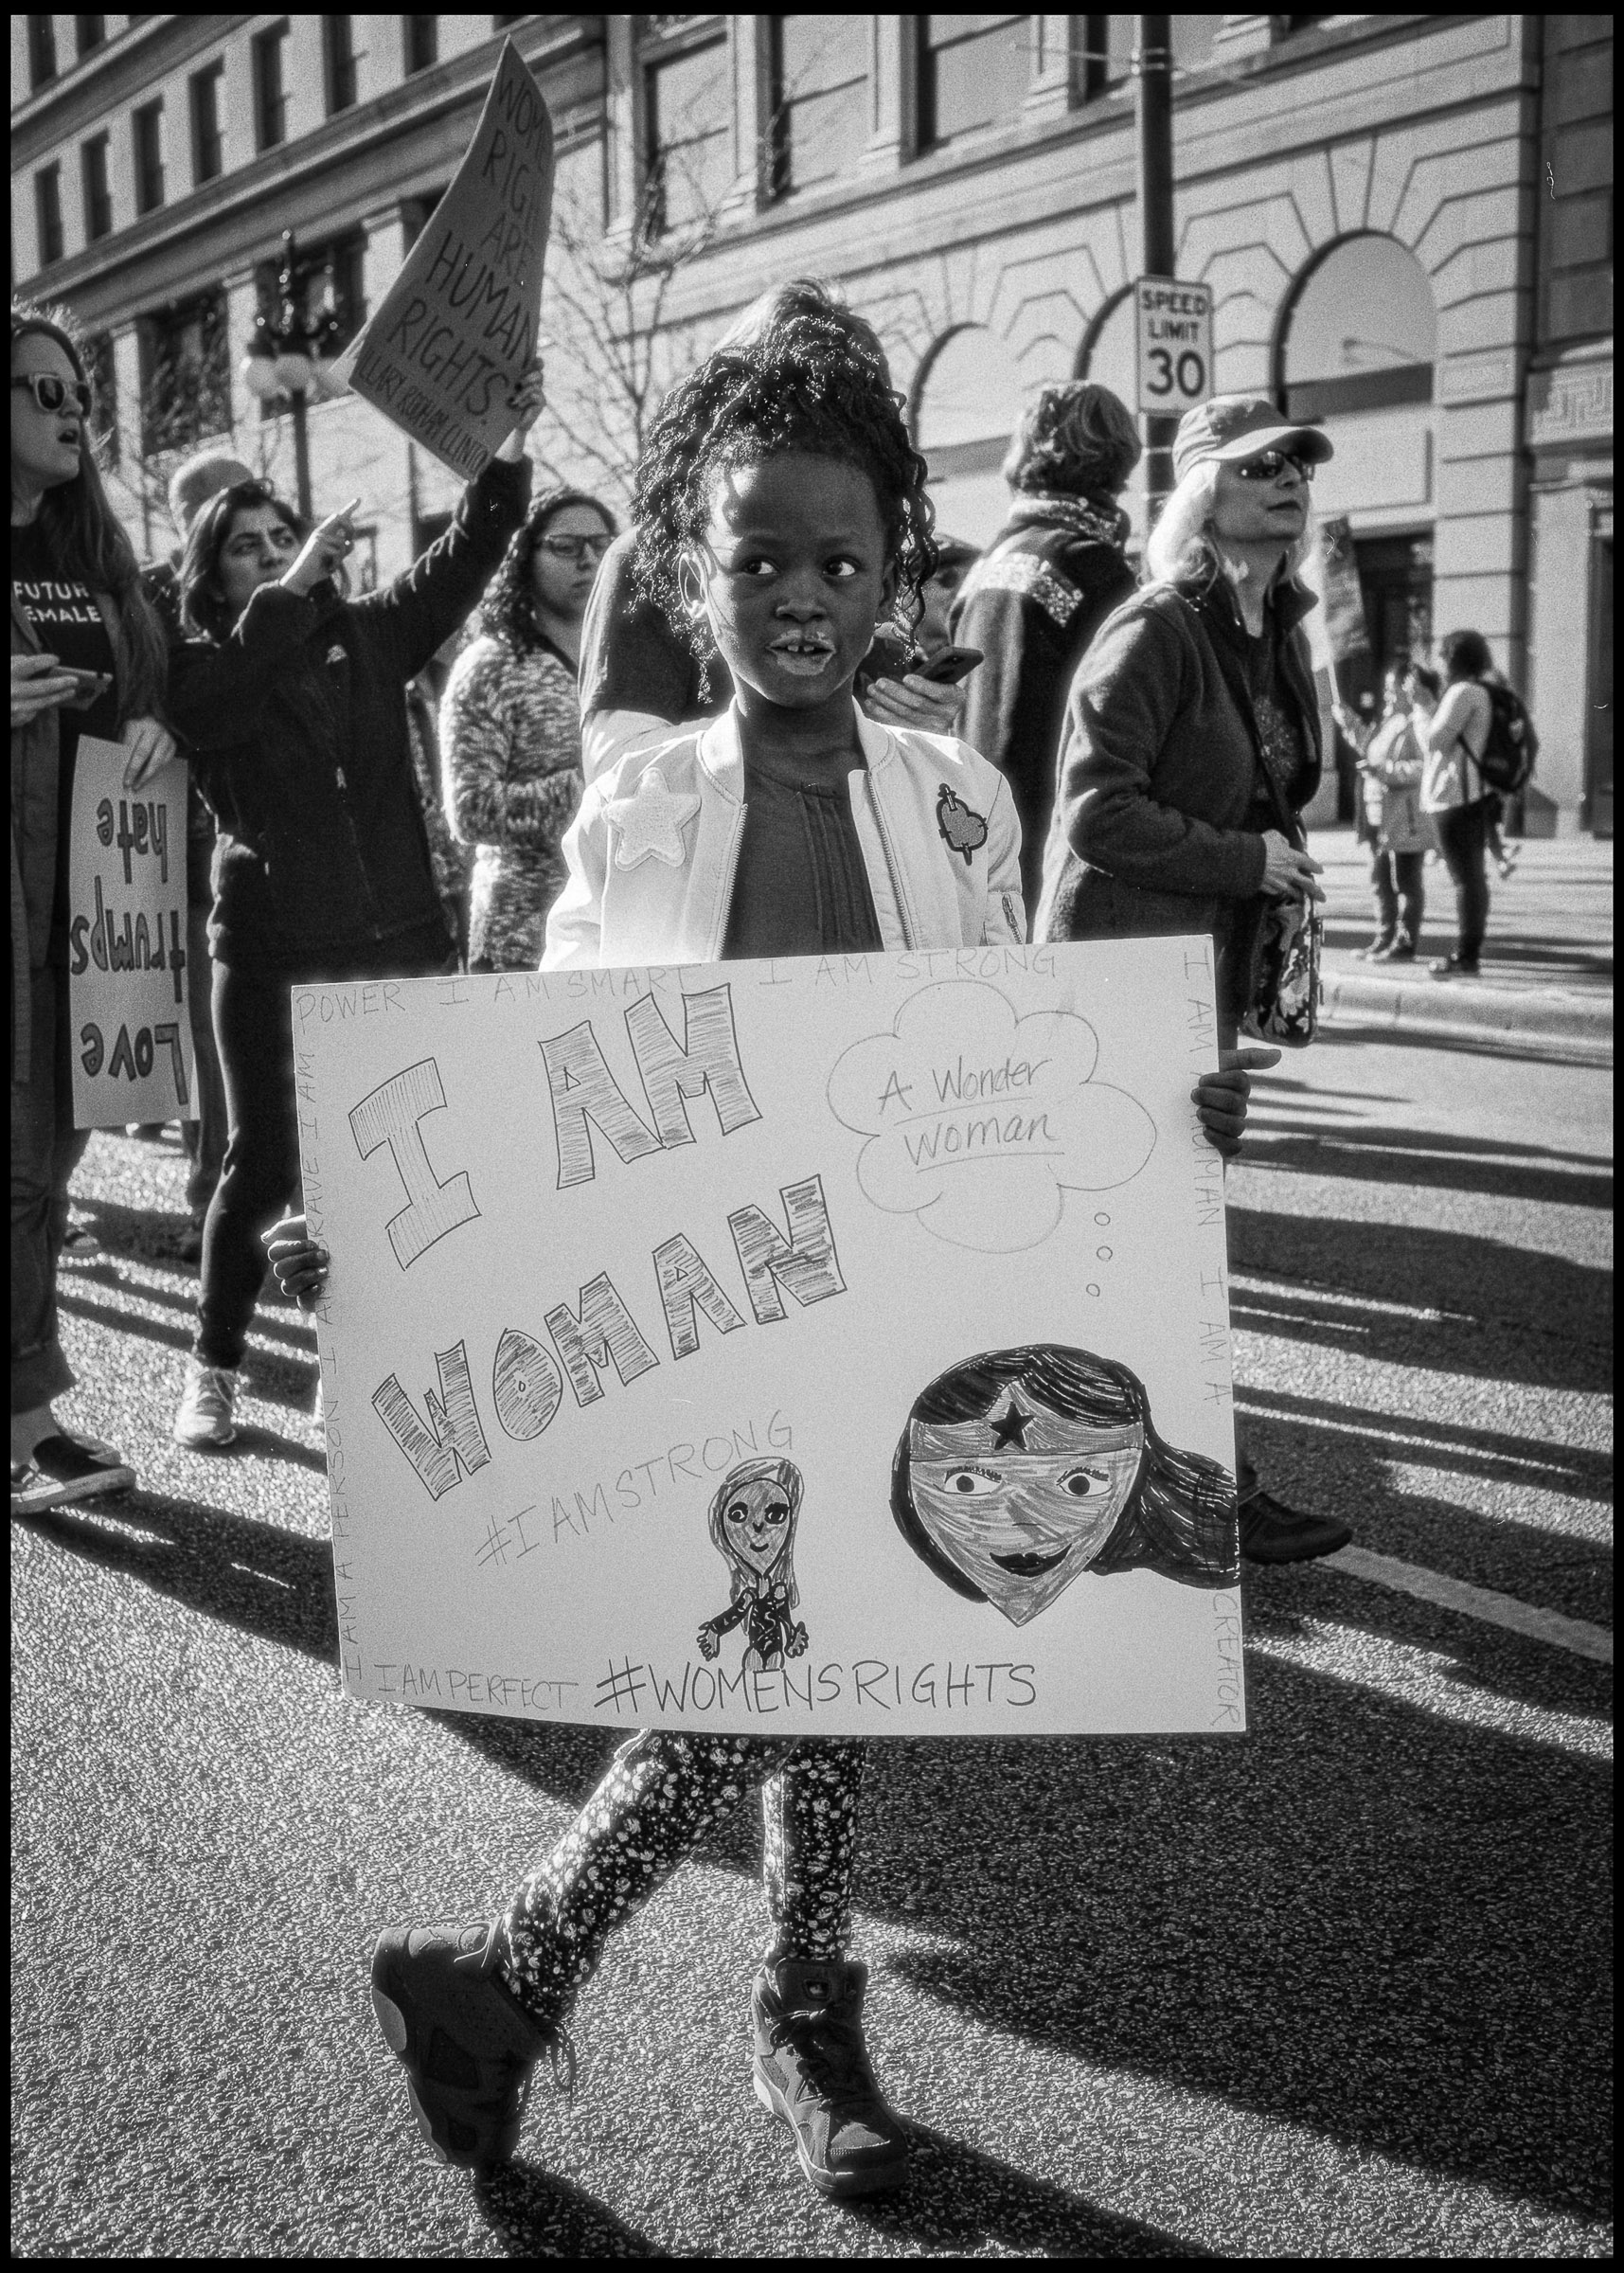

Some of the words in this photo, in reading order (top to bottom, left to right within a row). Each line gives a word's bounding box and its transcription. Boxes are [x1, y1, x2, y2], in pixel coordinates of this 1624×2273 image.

[498, 72, 546, 172] WOM
[426, 230, 531, 370] HUMAN
[1142, 290, 1205, 315] SPEED
[1148, 318, 1199, 342] LIMIT
[1147, 347, 1205, 398] 30
[438, 423, 489, 473] CLINTO
[12, 580, 90, 600] FUTUR
[23, 605, 101, 622] EMALE
[97, 797, 168, 884] hate
[70, 874, 186, 1003] trumps
[1184, 945, 1212, 981] I
[295, 982, 405, 1036] POWER
[437, 979, 470, 1006] I
[493, 975, 550, 1003] AM
[567, 963, 703, 997] SMART
[758, 957, 793, 986] I
[814, 954, 872, 987] AM
[896, 947, 1056, 979] STRONG
[1187, 997, 1215, 1053] AM
[80, 1022, 188, 1106] Love
[296, 1052, 317, 1104] AM
[877, 1069, 913, 1116] A
[931, 1054, 1053, 1103] Wonder
[298, 1109, 318, 1140] I
[348, 1056, 482, 1272] I
[538, 982, 763, 1190] AM
[1199, 1265, 1225, 1298] I
[319, 1346, 337, 1375] I
[371, 1173, 848, 1502] WOMAN
[1199, 1320, 1227, 1365] AM
[1203, 1381, 1231, 1406] A
[324, 1400, 350, 1548] PERSON
[335, 1562, 353, 1581] A
[338, 1596, 359, 1645] AM
[344, 1655, 363, 1683] I
[1211, 1592, 1242, 1727] CREATOR
